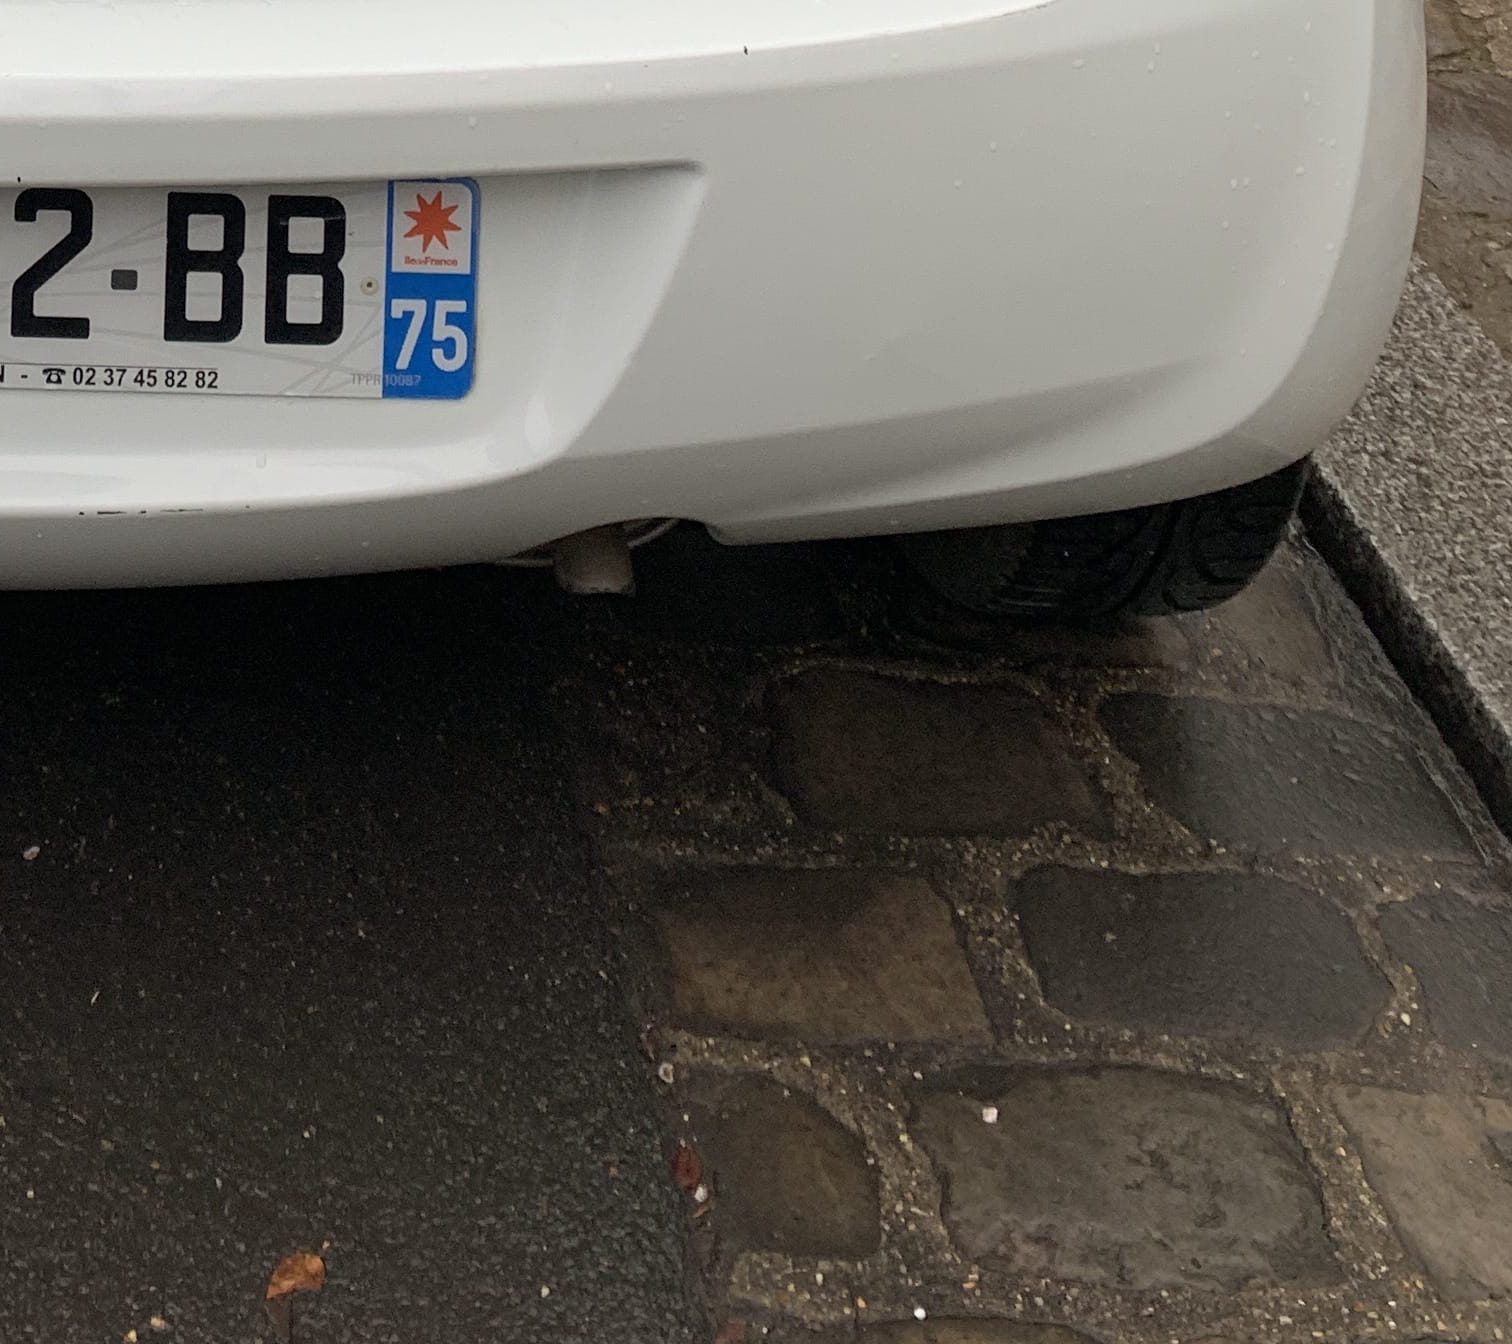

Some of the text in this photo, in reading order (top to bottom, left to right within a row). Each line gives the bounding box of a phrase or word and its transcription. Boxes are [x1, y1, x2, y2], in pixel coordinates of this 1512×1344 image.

[390, 298, 468, 373] 75
[72, 368, 95, 387] 02
[103, 368, 127, 387] 37
[134, 368, 158, 388] 45
[164, 369, 188, 389] 82
[194, 370, 219, 390] 82
